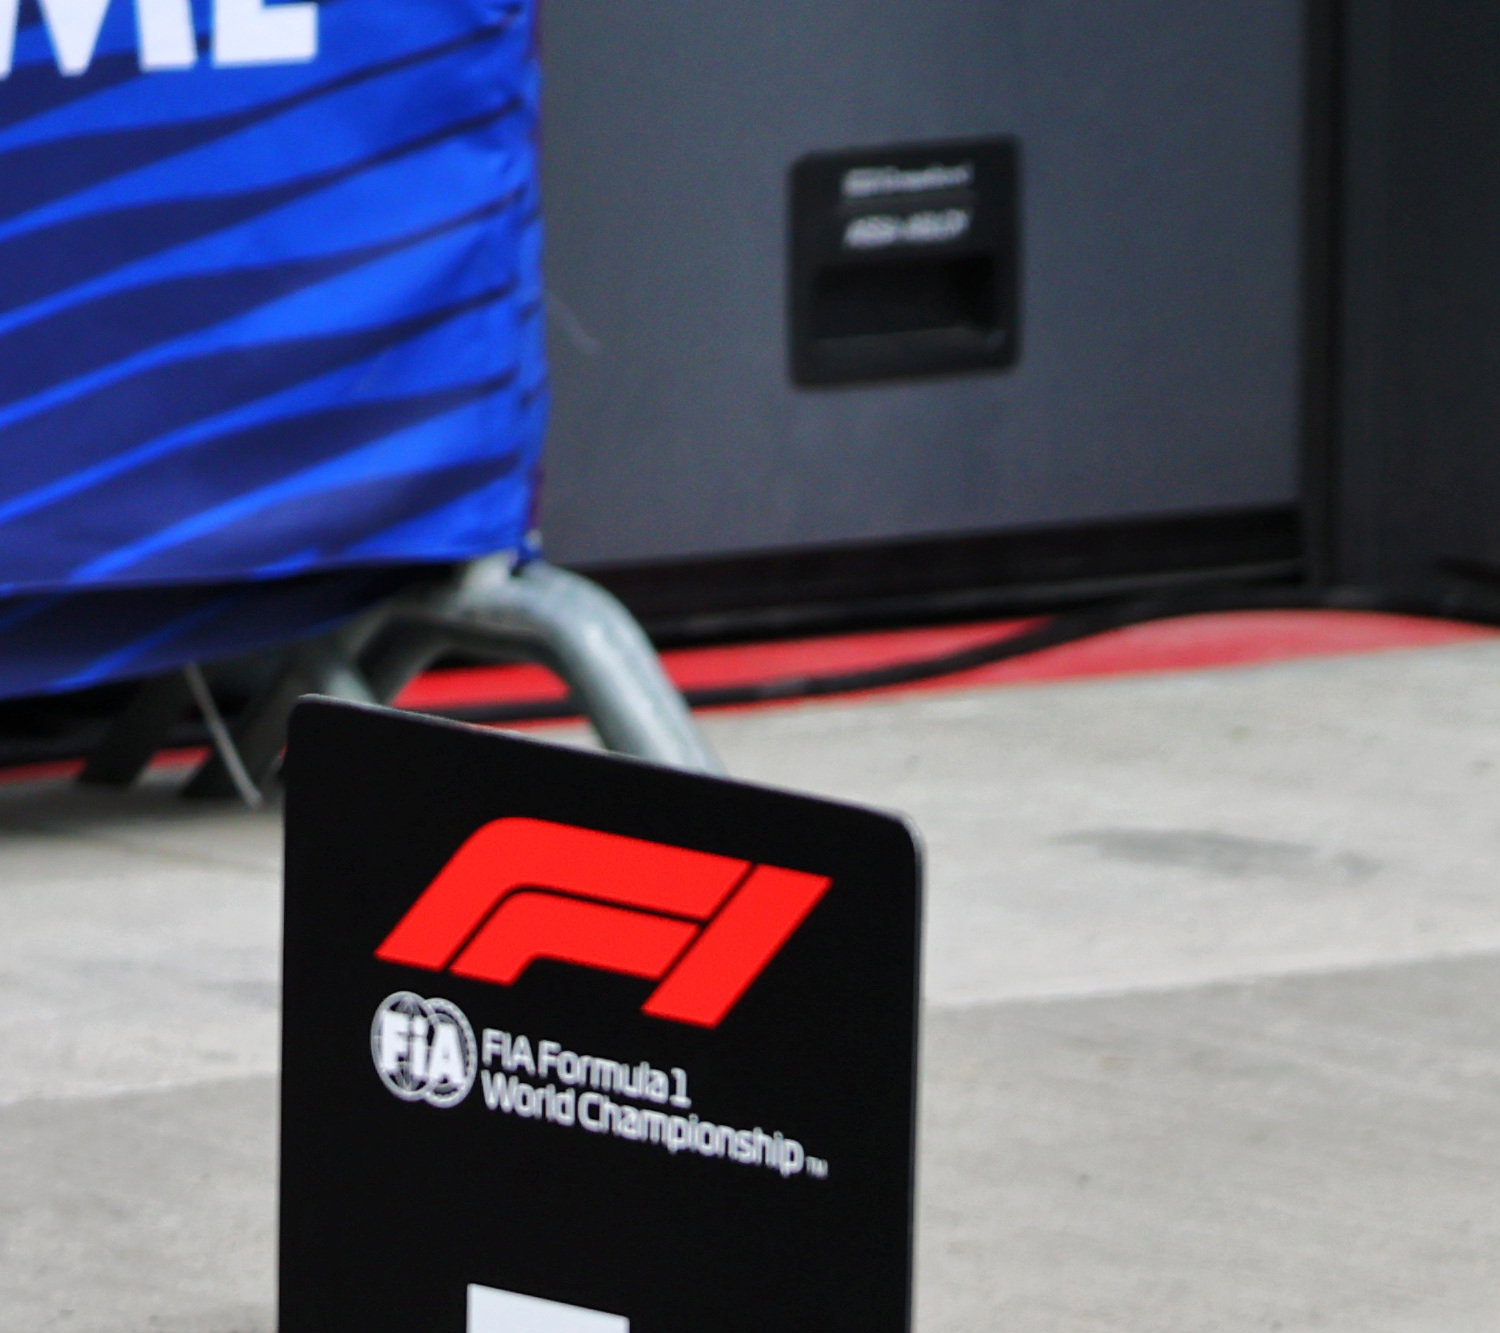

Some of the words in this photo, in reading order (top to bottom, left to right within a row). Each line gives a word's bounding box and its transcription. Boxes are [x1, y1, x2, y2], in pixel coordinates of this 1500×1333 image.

[480, 1069, 575, 1127] World
[481, 1027, 535, 1075] FIA
[538, 1039, 670, 1101] Formula
[671, 1066, 693, 1109] 1
